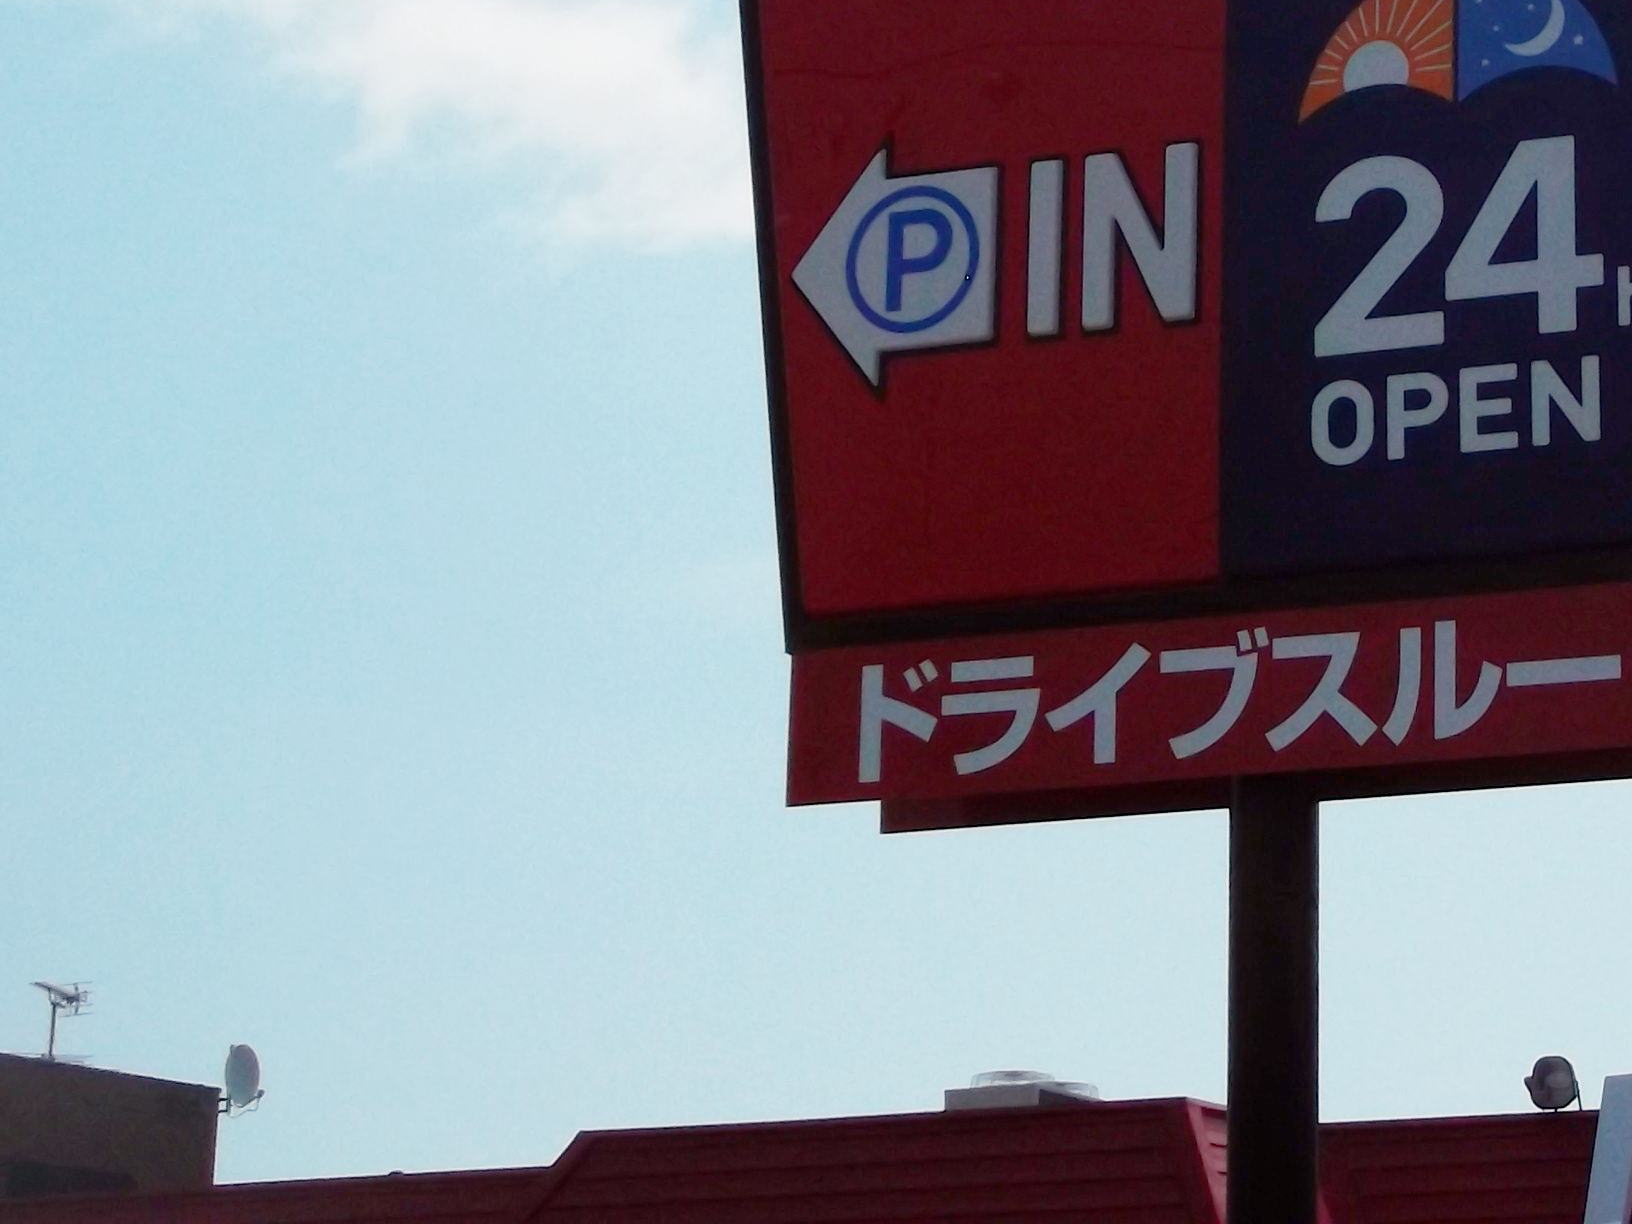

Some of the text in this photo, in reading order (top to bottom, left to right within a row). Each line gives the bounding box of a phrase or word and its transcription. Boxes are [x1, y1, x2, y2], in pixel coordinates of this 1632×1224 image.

[883, 140, 1200, 338] P IN
[1309, 353, 1602, 467] OPEN
[857, 619, 1623, 783] ドライブスルー
